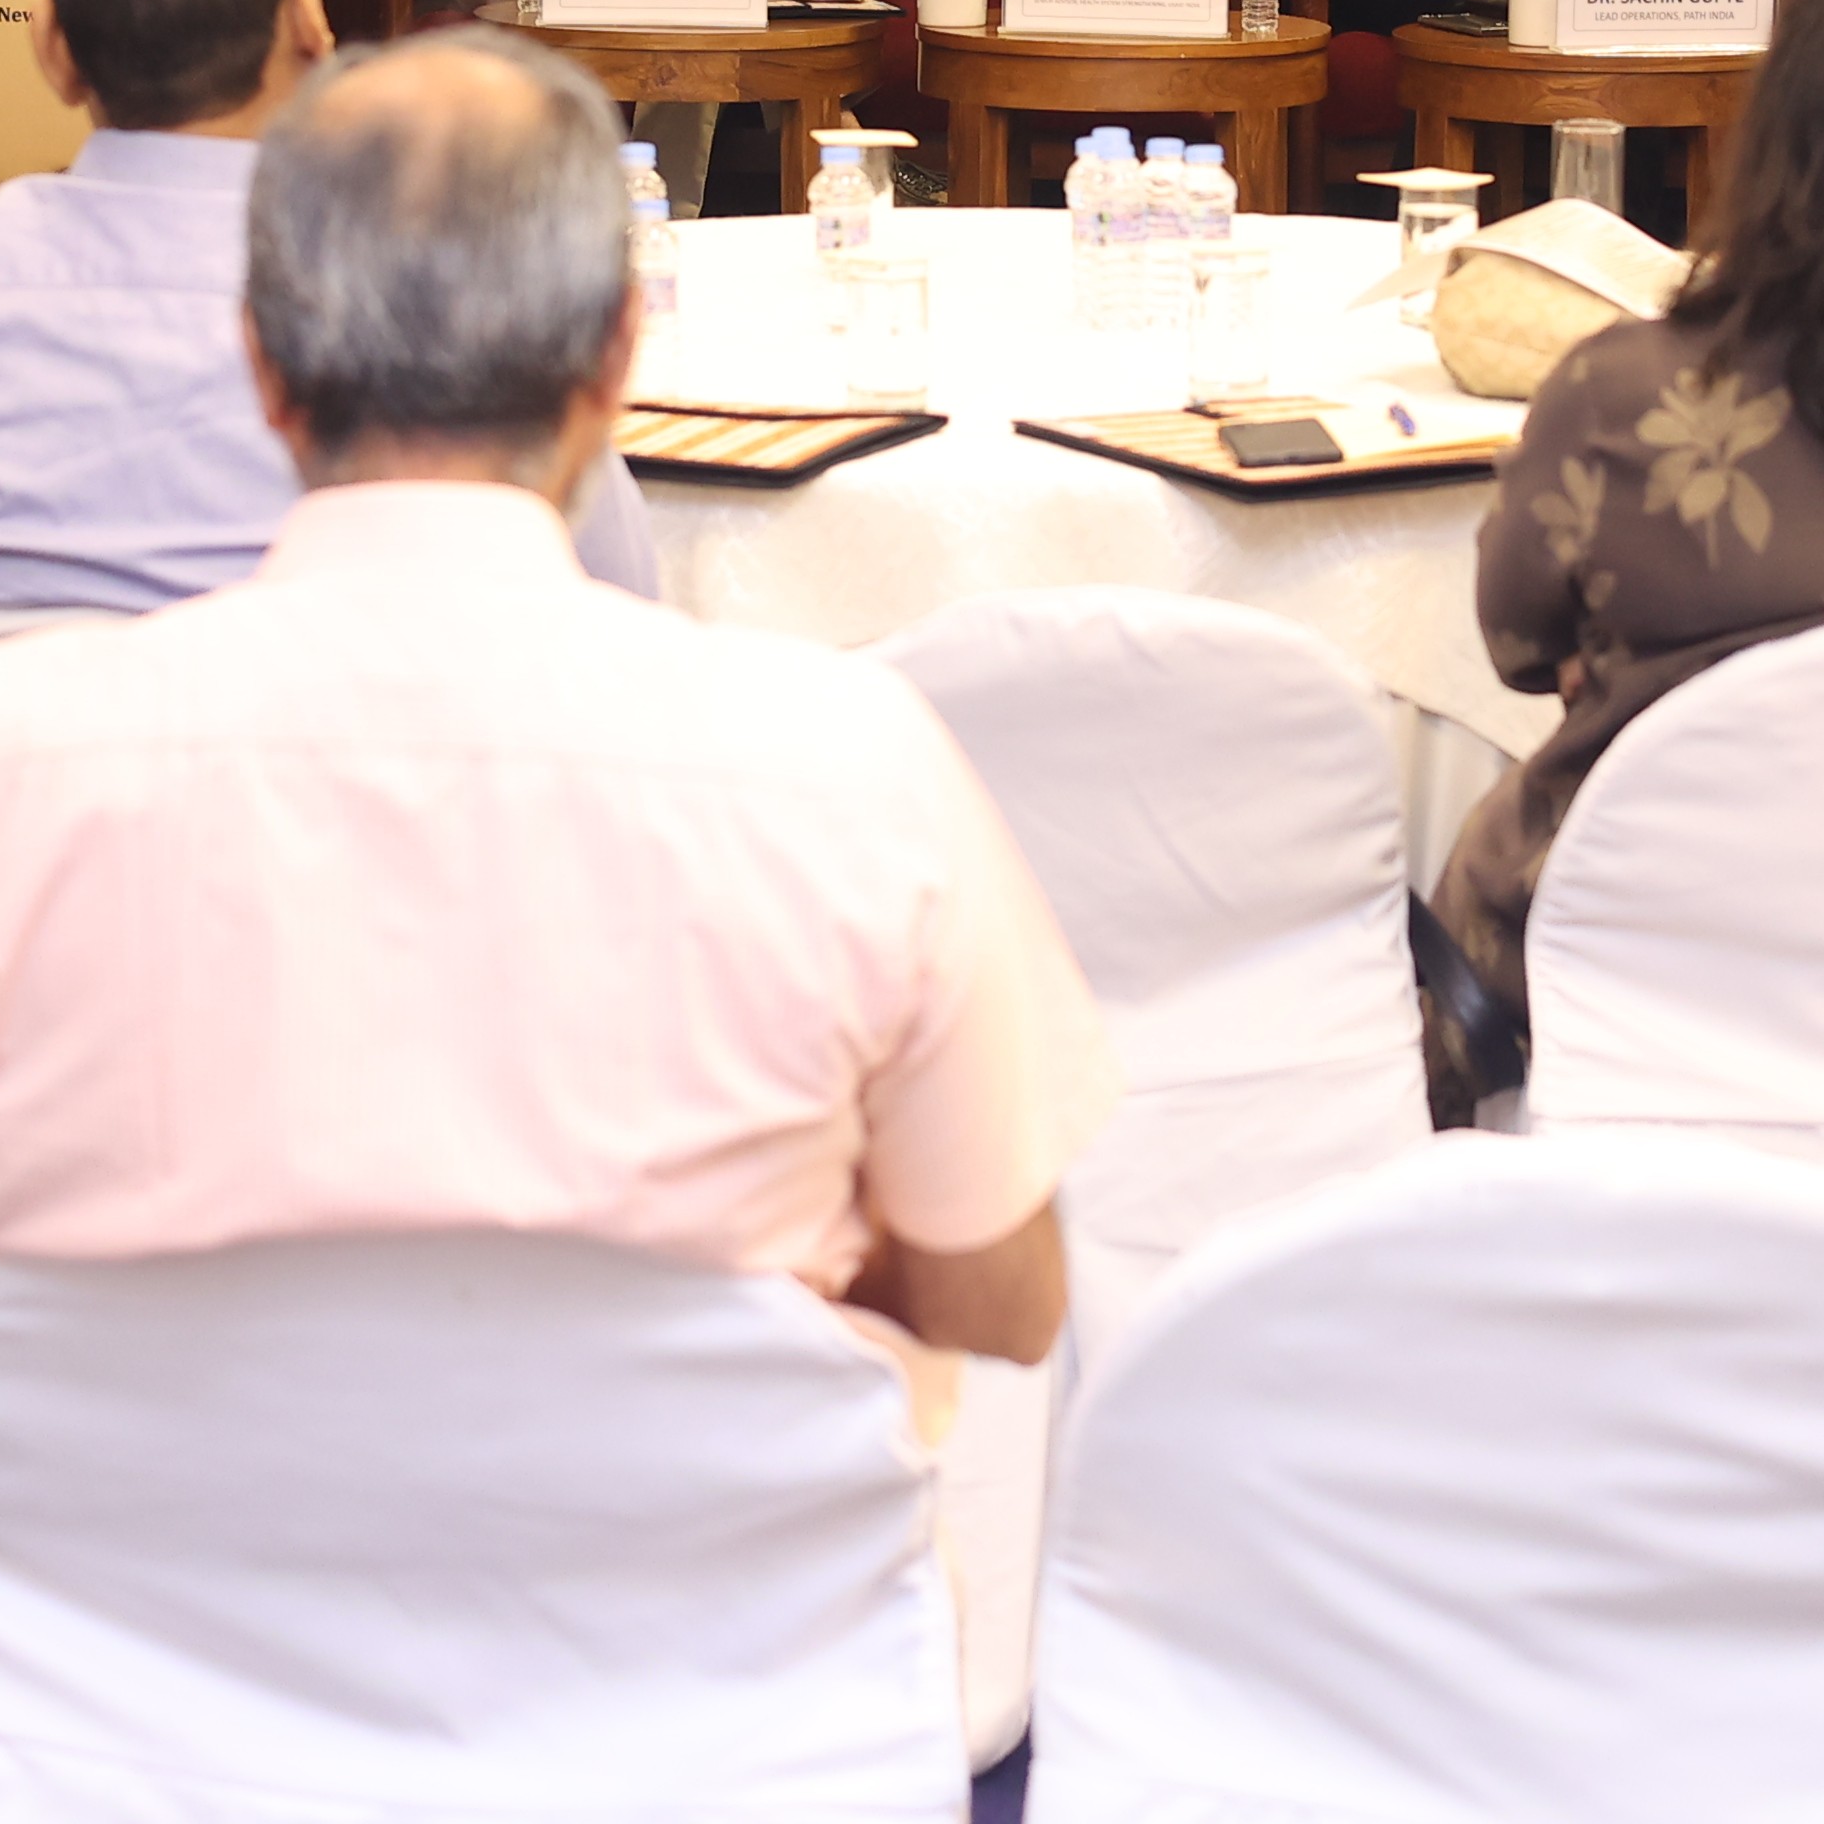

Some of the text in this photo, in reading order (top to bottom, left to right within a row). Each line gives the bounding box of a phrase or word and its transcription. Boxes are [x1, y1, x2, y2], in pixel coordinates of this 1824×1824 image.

[1595, 12, 1618, 21] LEAD
[1621, 12, 1680, 21] OPERATIONS,
[1709, 11, 1734, 19] INDIA
